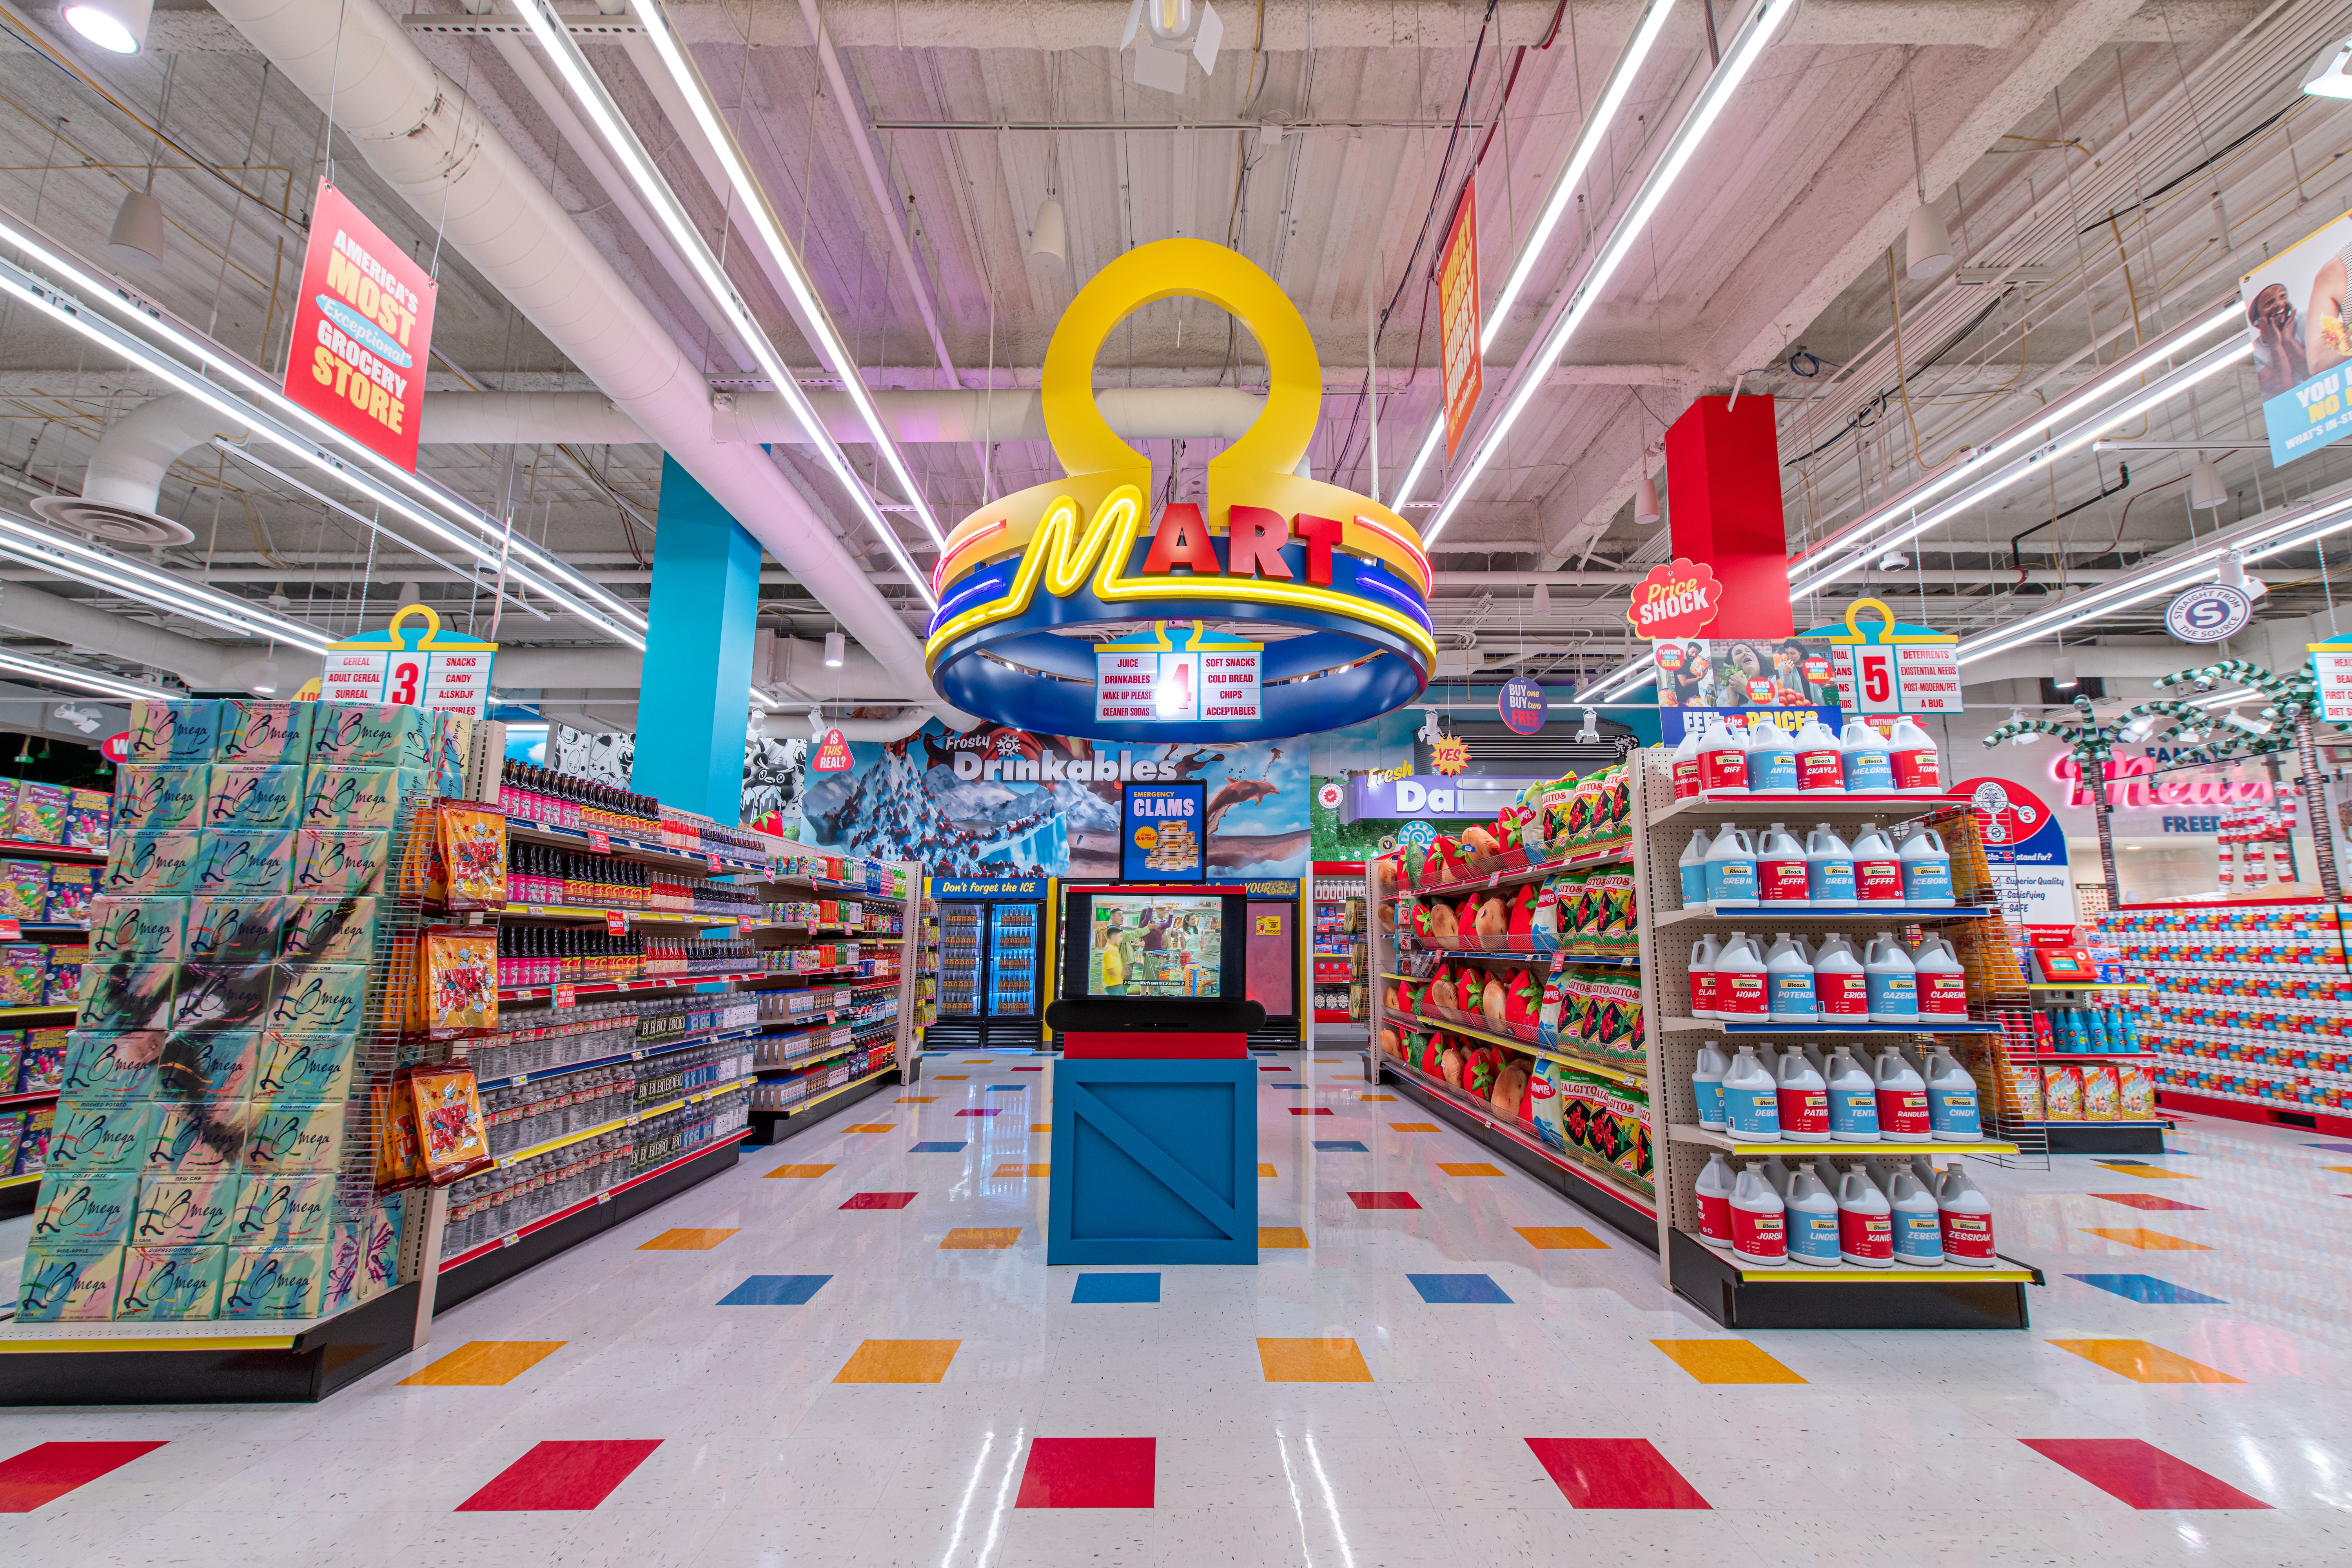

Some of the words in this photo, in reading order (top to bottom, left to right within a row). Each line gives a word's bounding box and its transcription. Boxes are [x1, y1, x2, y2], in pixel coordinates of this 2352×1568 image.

[1442, 199, 1472, 310] HURRY
[334, 229, 418, 313] AMERICA'S
[1443, 236, 1473, 346] HURRY
[326, 248, 416, 348] MOST
[1445, 274, 1474, 381] HURRY
[318, 320, 407, 399] GROCERY
[1446, 312, 1475, 414] HURRY
[312, 346, 405, 435] STORE
[2296, 372, 2339, 408] YOU
[2309, 395, 2339, 424] NO
[2285, 422, 2324, 450] WHAT'S
[1005, 485, 1343, 606] MART
[1647, 578, 1697, 604] Price
[1640, 587, 1709, 624] SHOCK
[2174, 591, 2214, 619] STRAIGHT
[2216, 592, 2241, 608] FROM
[2192, 602, 2223, 626] S
[2180, 625, 2198, 637] THE
[2201, 616, 2240, 637] SOURCE
[343, 657, 370, 666] CEREAL
[1903, 651, 1949, 659] DETERRENTS
[446, 658, 476, 666] SNACKS
[1118, 659, 1138, 668] JUICE
[1206, 659, 1223, 667] SOFT
[1226, 658, 1255, 666] SNACKS
[1901, 667, 1936, 675] EXISTENTIAL
[1938, 666, 1956, 675] NEEDS
[328, 673, 352, 682] ADULT
[353, 673, 380, 682] CEREAL
[392, 662, 419, 705] 3
[446, 674, 472, 682] CANDY
[1105, 675, 1150, 684] DRINKABLES
[1208, 675, 1227, 683] COLD
[1229, 674, 1253, 682] BREAD
[1863, 656, 1889, 702] 5
[1171, 664, 1191, 709] 4
[1509, 684, 1526, 697] BUY
[1904, 683, 1956, 691] POST-MODERN/PET
[335, 690, 368, 699] SURREAL
[1103, 691, 1120, 700] WAKE
[1121, 691, 1129, 700] UP
[1131, 691, 1152, 700] PLEASE
[1220, 690, 1242, 699] CHIPS
[1510, 696, 1527, 709] BUY
[1528, 701, 1541, 710] two
[1921, 699, 1926, 708] A
[1103, 708, 1129, 716] CLEANER
[1130, 708, 1149, 716] SODAS
[1207, 707, 1256, 716] ACCEPTABLES
[1512, 710, 1540, 727] FREE
[1683, 711, 1720, 731] FEE
[1727, 716, 1743, 726] the
[830, 733, 838, 745] IS
[946, 733, 990, 750] Frosty
[823, 744, 842, 757] THIS
[1439, 749, 1461, 762] YES
[820, 756, 846, 769] REAL?
[954, 750, 1177, 781] Drinkables
[1367, 760, 1413, 788] Fresh
[1806, 767, 1837, 775] SKAYLA
[1320, 785, 1335, 795] CERTIFIED
[1977, 784, 1993, 797] STRAIGHT
[1994, 784, 2006, 797] FROM
[76, 792, 107, 803] CRISPR
[72, 800, 109, 811] CRUNCH
[1134, 799, 1194, 817] CLAMS
[2019, 807, 2035, 815] ADDITIVE
[2024, 812, 2031, 821] S
[1864, 877, 1895, 886] JEFFFF
[2006, 877, 2036, 886] Superior
[2038, 877, 2064, 886] Quality
[942, 882, 967, 892] Don't
[970, 882, 999, 895] forget
[1002, 882, 1017, 892] the
[1020, 882, 1036, 892] ICE
[2007, 891, 2045, 900] Satisfying
[1867, 1233, 1892, 1241] XANIEL
[1949, 1230, 1991, 1242] ZESSICAK
